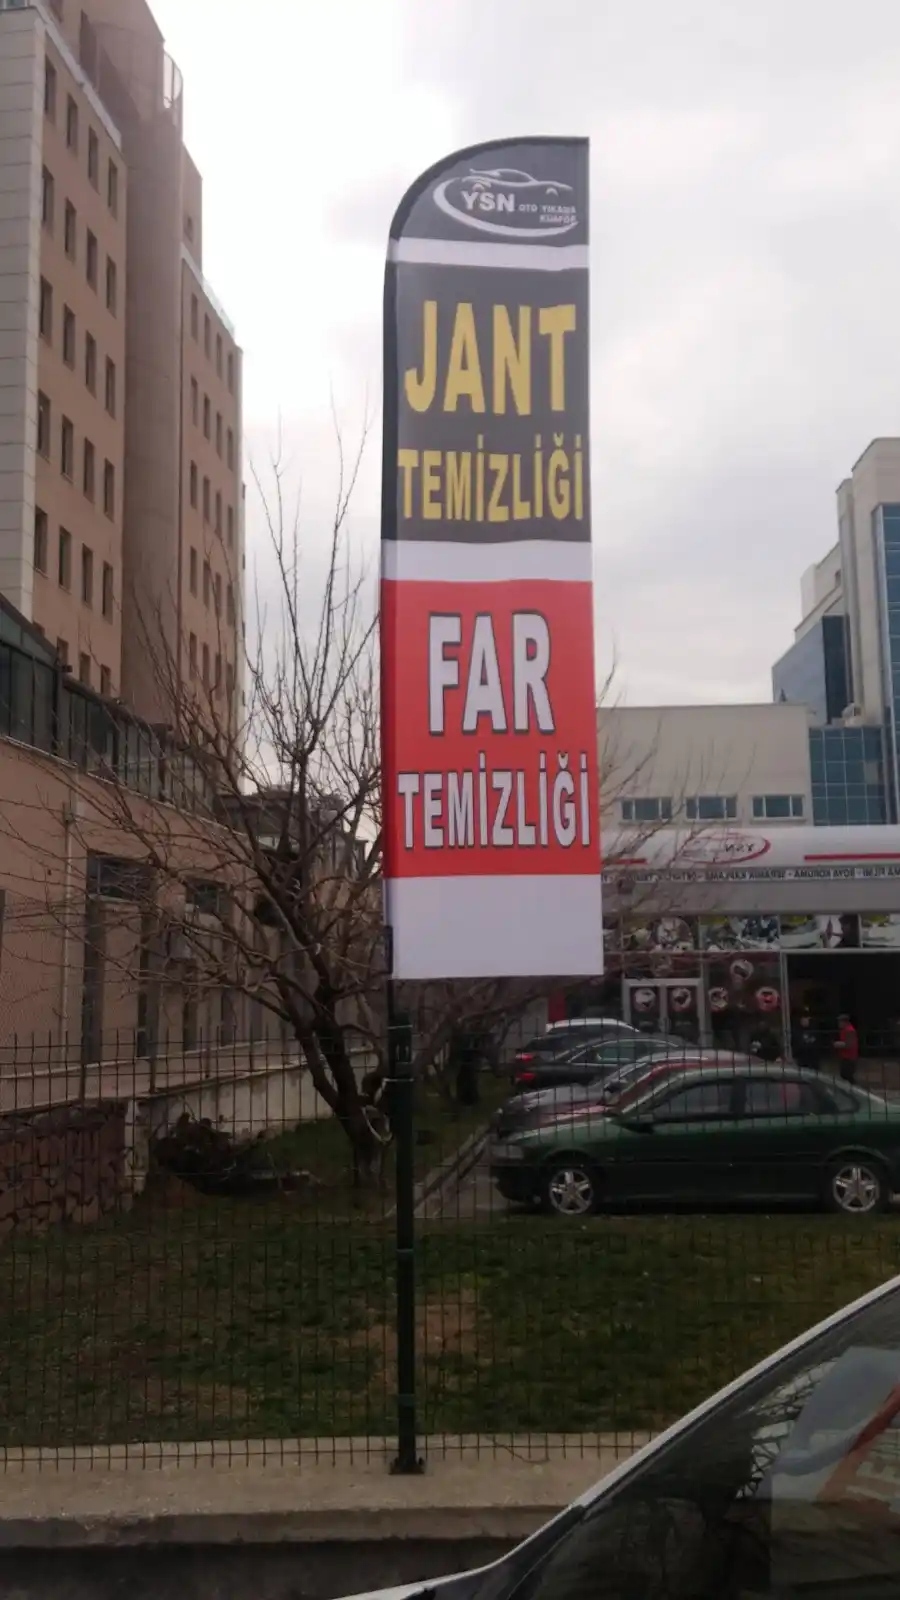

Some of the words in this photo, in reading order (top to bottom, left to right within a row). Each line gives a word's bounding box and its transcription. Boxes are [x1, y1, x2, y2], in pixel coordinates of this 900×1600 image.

[461, 191, 514, 212] YSN
[518, 203, 537, 212] OTO
[404, 300, 577, 415] JANT
[398, 432, 584, 522] TEMİZLİĞİ
[428, 610, 555, 735] FAR
[397, 750, 590, 849] TEMİZLİĞİ
